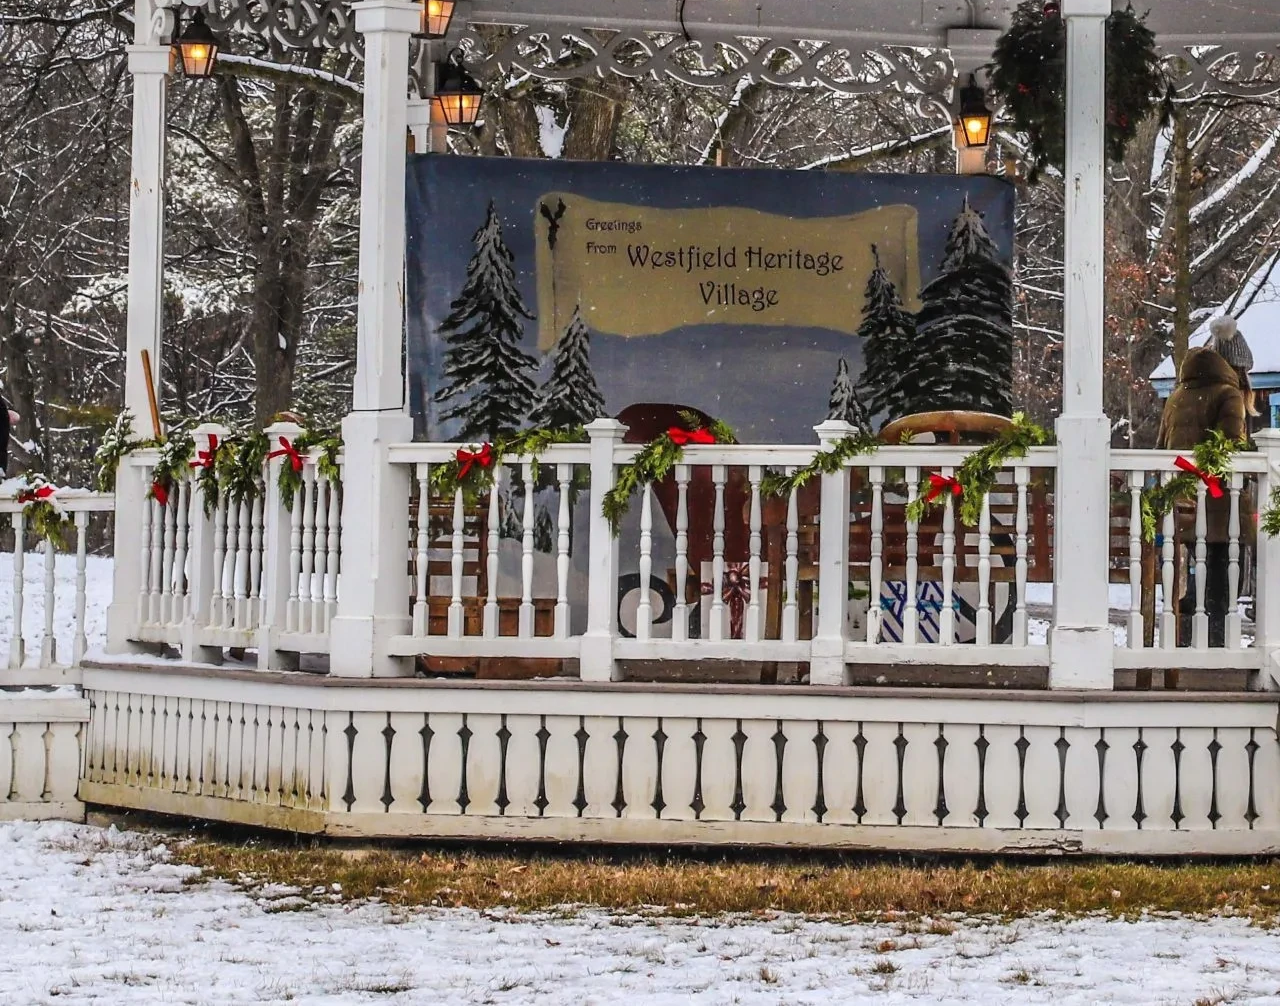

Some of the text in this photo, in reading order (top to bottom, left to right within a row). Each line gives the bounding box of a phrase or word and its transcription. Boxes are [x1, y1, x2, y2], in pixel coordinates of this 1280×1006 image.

[585, 218, 642, 234] Greetings
[586, 241, 844, 276] From Westfield Heritage
[699, 280, 779, 311] Village
